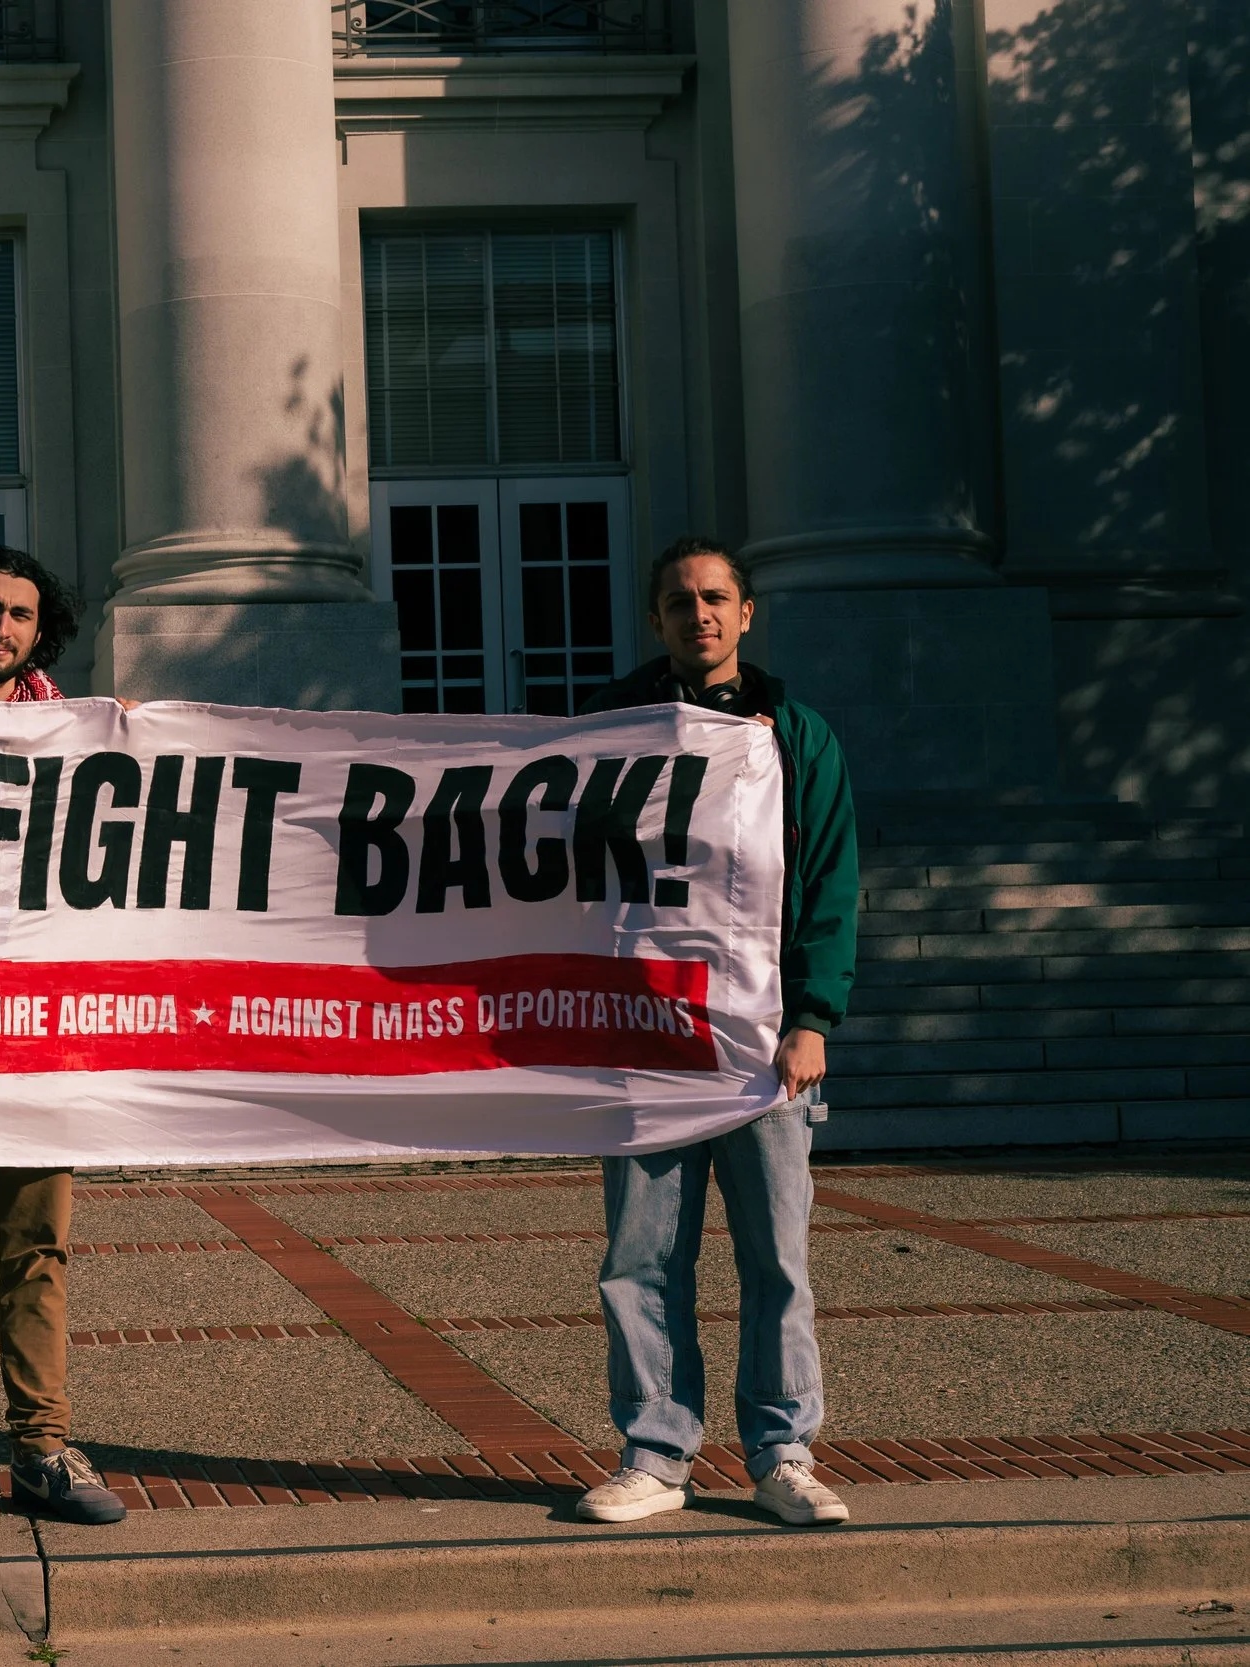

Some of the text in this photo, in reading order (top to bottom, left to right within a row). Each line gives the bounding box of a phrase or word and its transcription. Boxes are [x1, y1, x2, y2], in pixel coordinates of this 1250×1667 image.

[334, 754, 710, 916] BACK!
[57, 994, 178, 1035] AGENDA
[228, 996, 361, 1039] AGAINST
[372, 996, 464, 1040] MASS
[477, 988, 695, 1038] DEPORTATIONS
